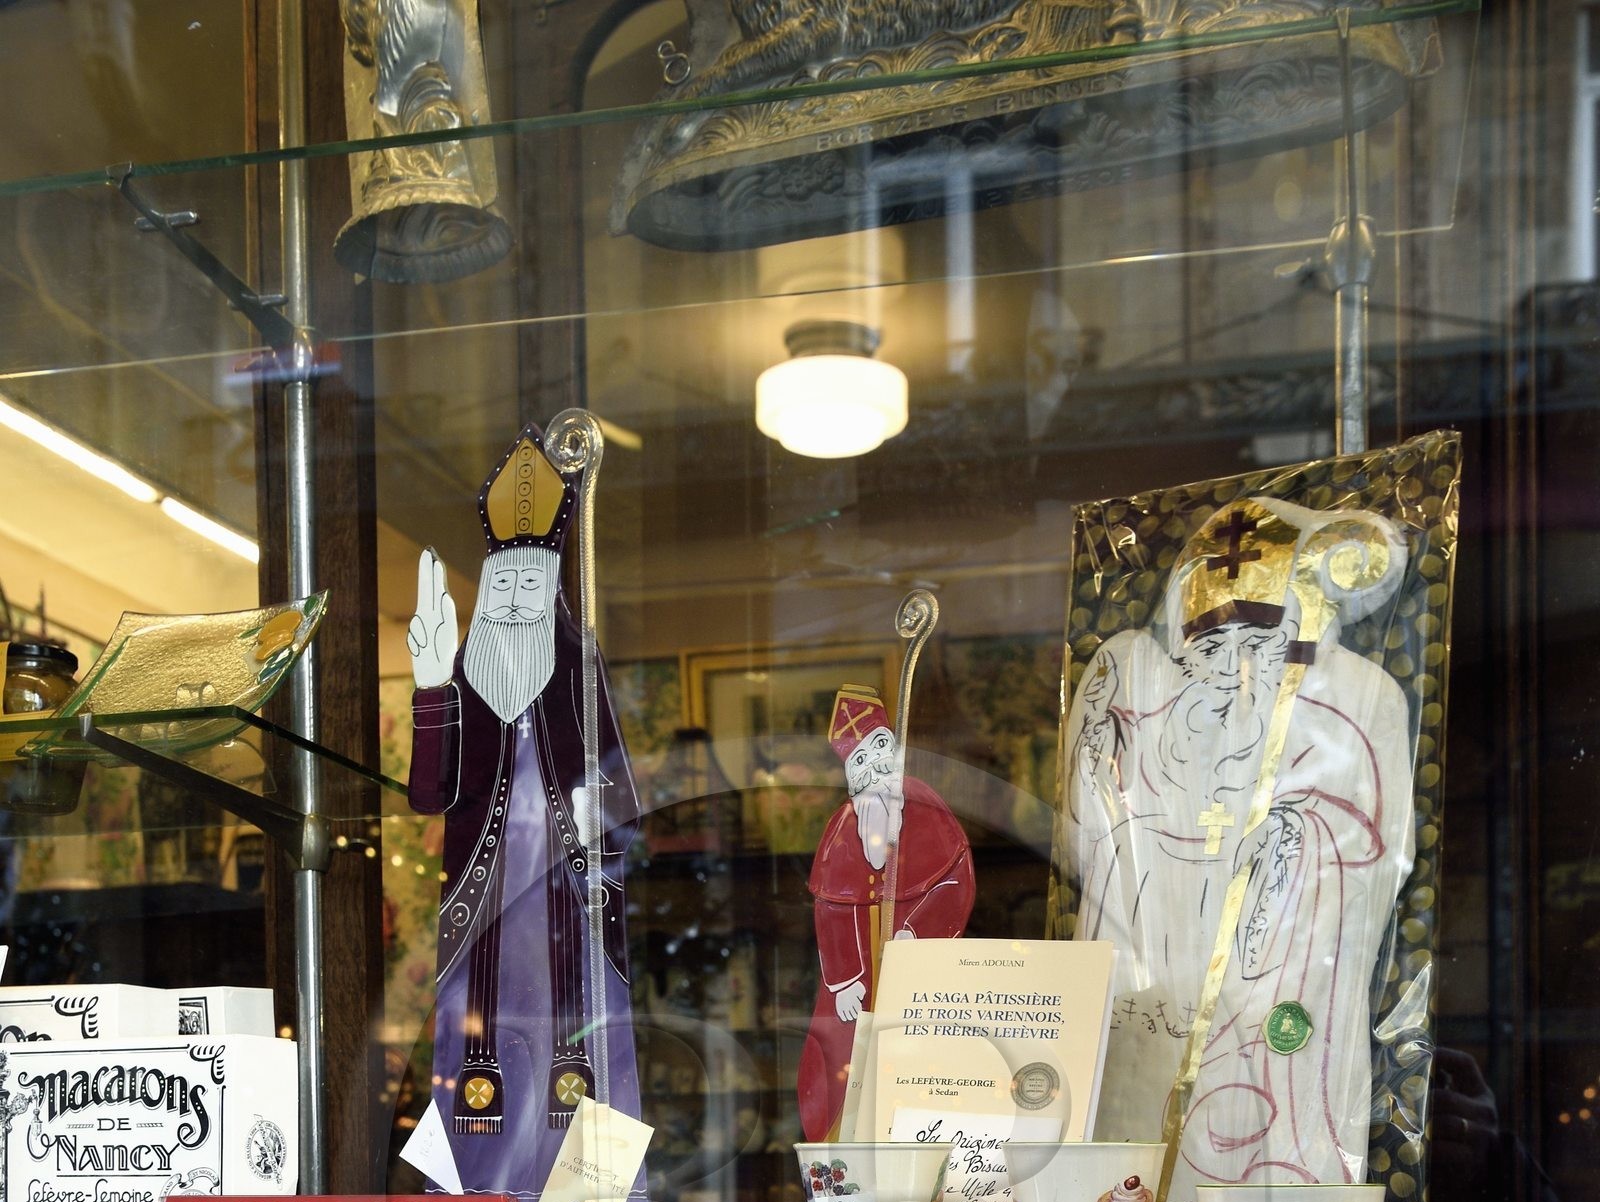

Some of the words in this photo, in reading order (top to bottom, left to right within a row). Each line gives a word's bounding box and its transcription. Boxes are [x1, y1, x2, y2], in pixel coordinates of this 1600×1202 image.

[958, 957, 981, 967] Miren
[982, 958, 1025, 968] ADOUANI
[912, 992, 929, 1003] LA
[933, 992, 970, 1004] SAGA
[975, 989, 1062, 1006] PÂTISSIÈRE
[903, 1008, 923, 1020] DE
[928, 1008, 973, 1021] TROIS
[977, 1009, 1066, 1025] VARENNOIS,
[904, 1024, 930, 1036] LES
[934, 1022, 990, 1038] FRÈRES
[994, 1026, 1061, 1040] LEFÈVRE
[896, 1077, 910, 1085] Les
[911, 1076, 997, 1088] LEFÈVRE-GEORGE
[935, 1088, 960, 1097] Sedan
[18, 1065, 211, 1150] macarons
[97, 1118, 132, 1131] DE
[27, 1134, 181, 1171] NANCY
